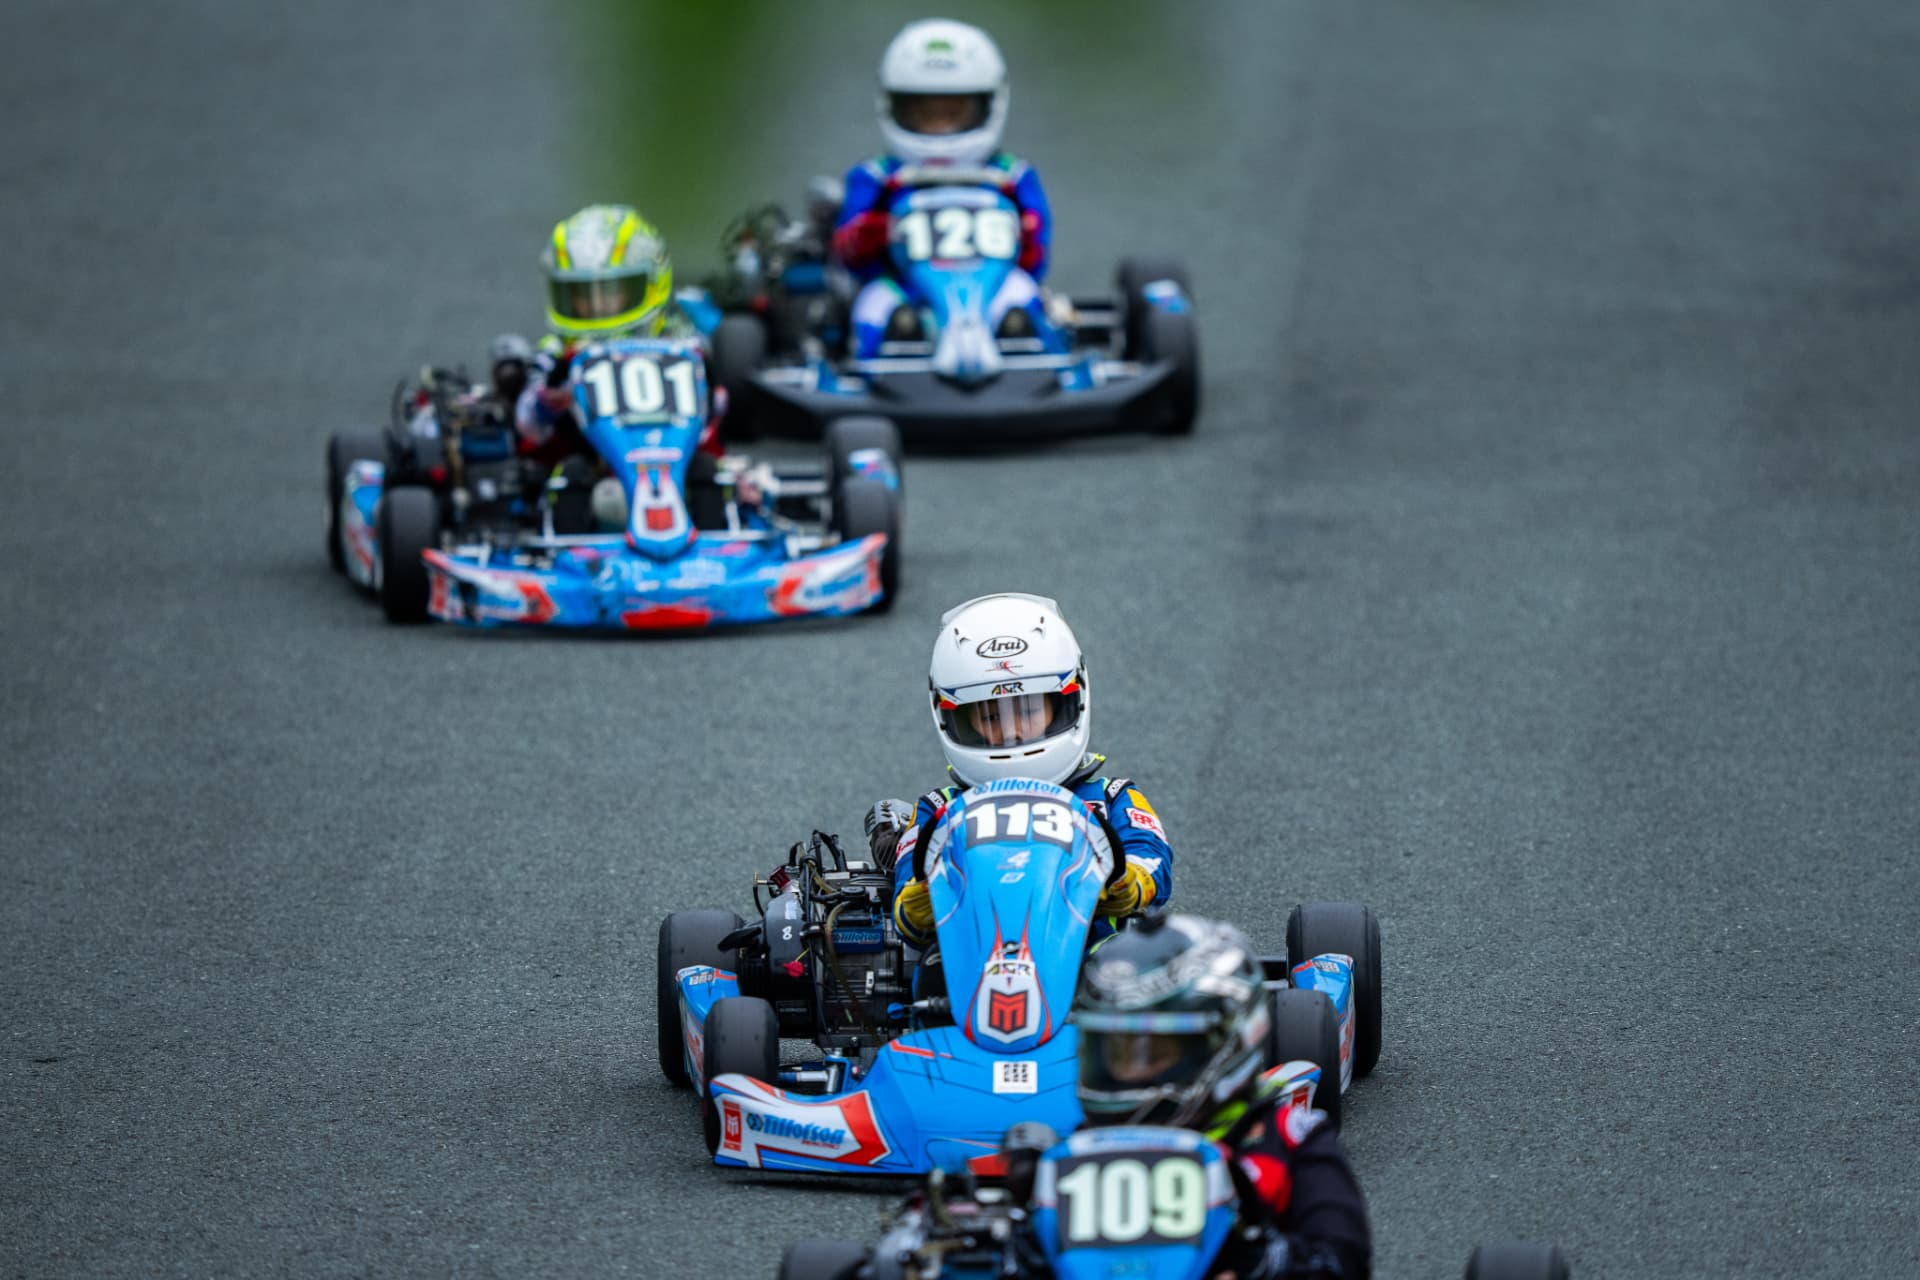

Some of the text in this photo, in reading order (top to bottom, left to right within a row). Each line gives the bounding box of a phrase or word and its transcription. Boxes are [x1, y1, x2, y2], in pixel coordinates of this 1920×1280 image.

[584, 357, 697, 418] 101
[980, 639, 1022, 655] Arai
[965, 802, 1074, 844] 113
[781, 925, 793, 941] 8
[1057, 1157, 1206, 1242] 109
